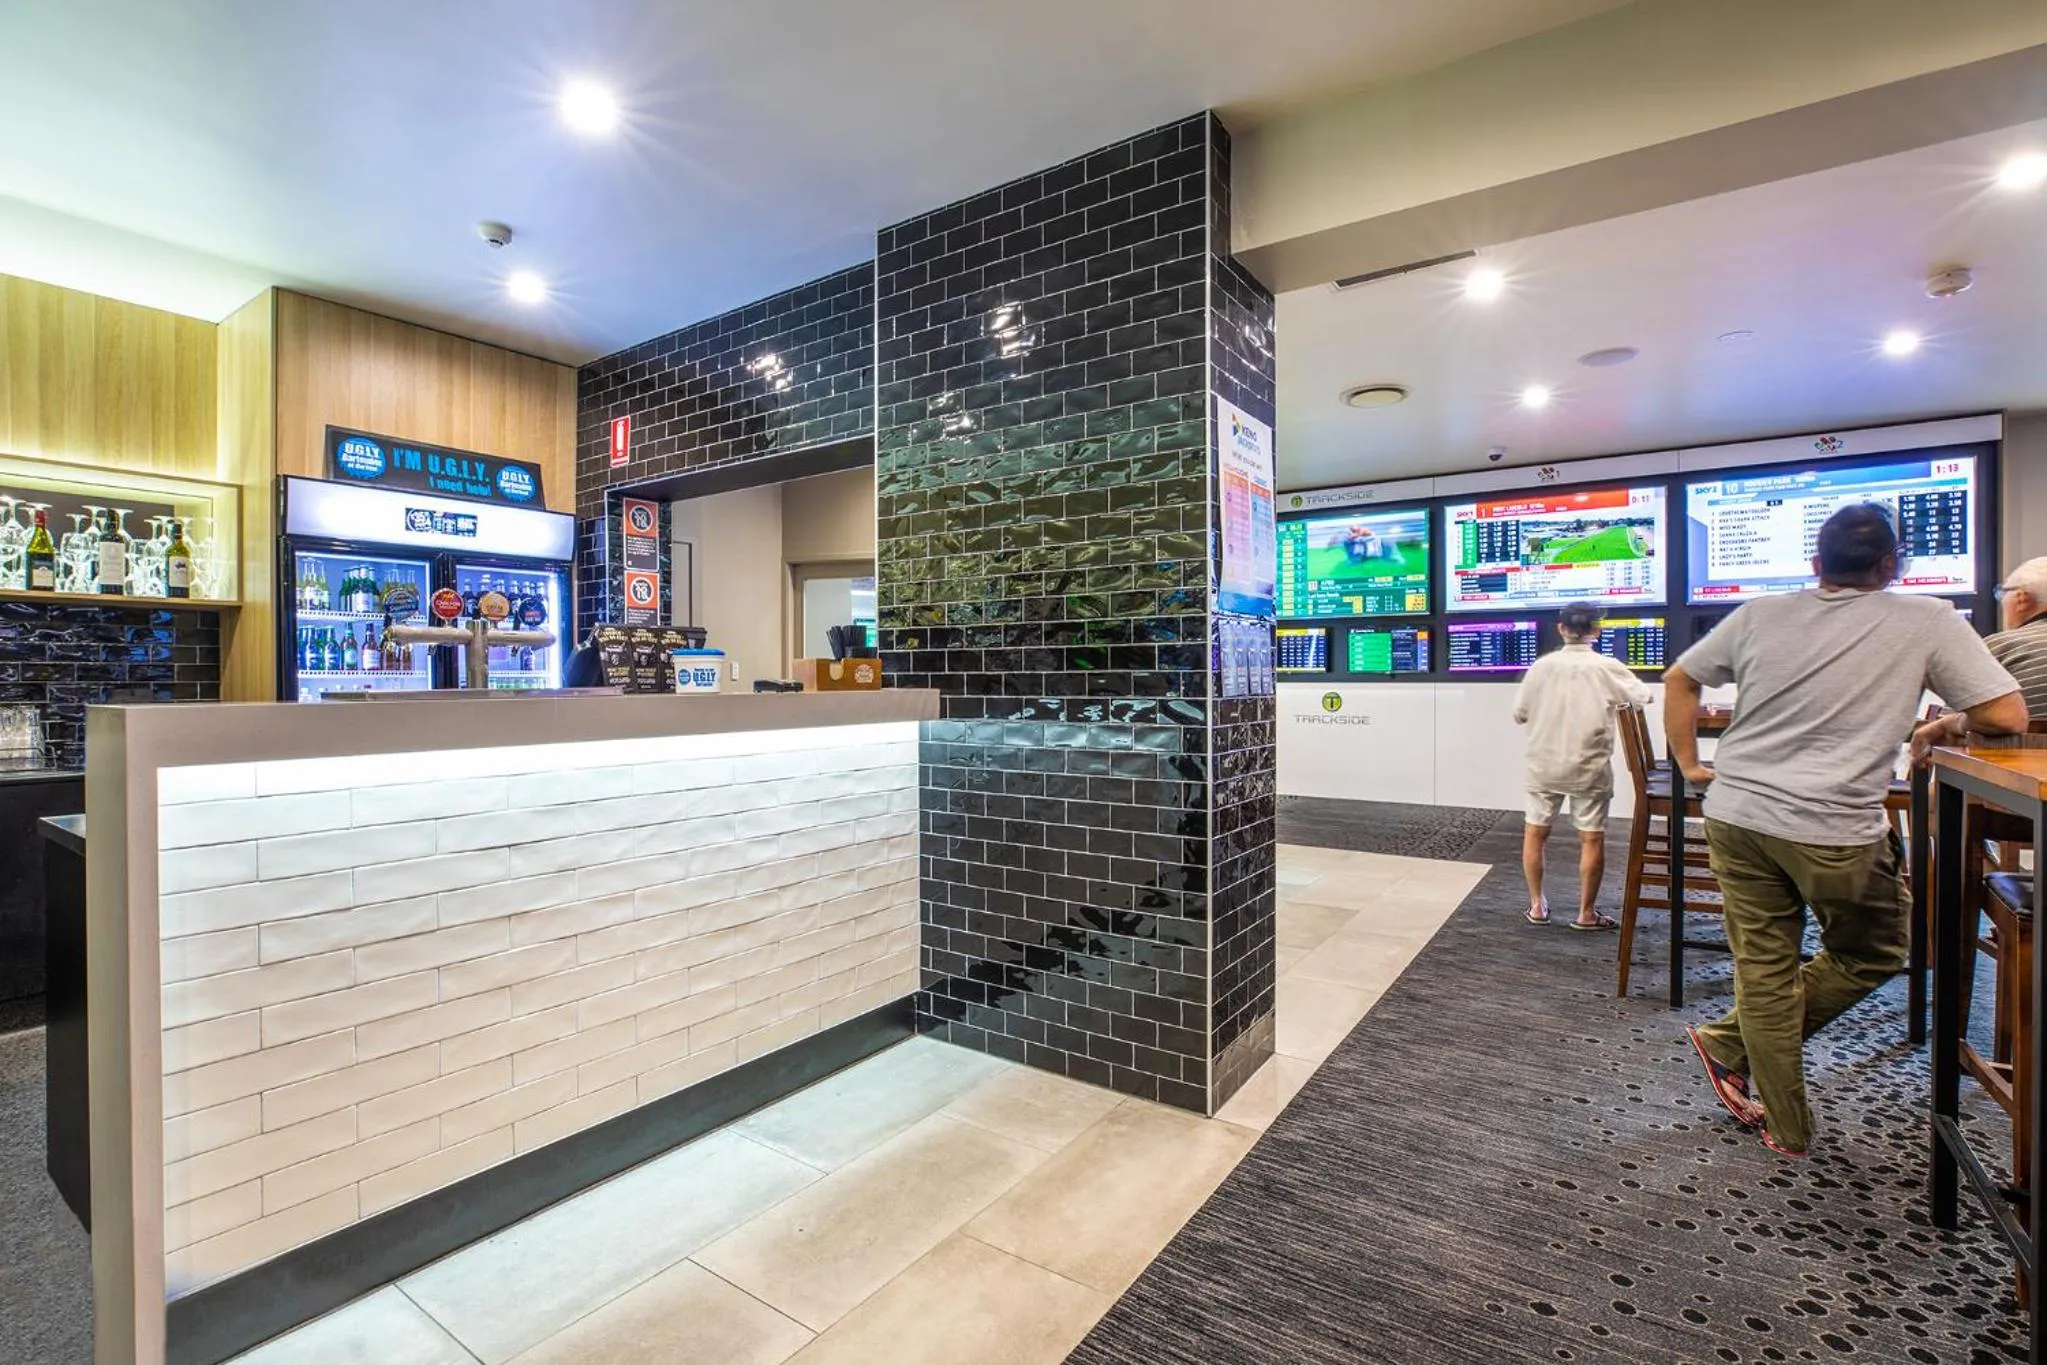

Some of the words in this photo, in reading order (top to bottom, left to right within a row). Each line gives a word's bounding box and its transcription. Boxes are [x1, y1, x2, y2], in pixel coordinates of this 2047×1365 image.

[1242, 424, 1258, 442] KENO
[345, 443, 379, 458] UGLY
[392, 447, 421, 471] I'M
[427, 453, 490, 482] U.G.L.Y.
[1936, 464, 1959, 474] 1:13
[502, 471, 529, 483] UGLY
[437, 479, 464, 493] need
[1307, 490, 1374, 505] TRACKSIDE
[692, 672, 716, 682] UGLY
[1294, 714, 1372, 725] TRACKSIDE
